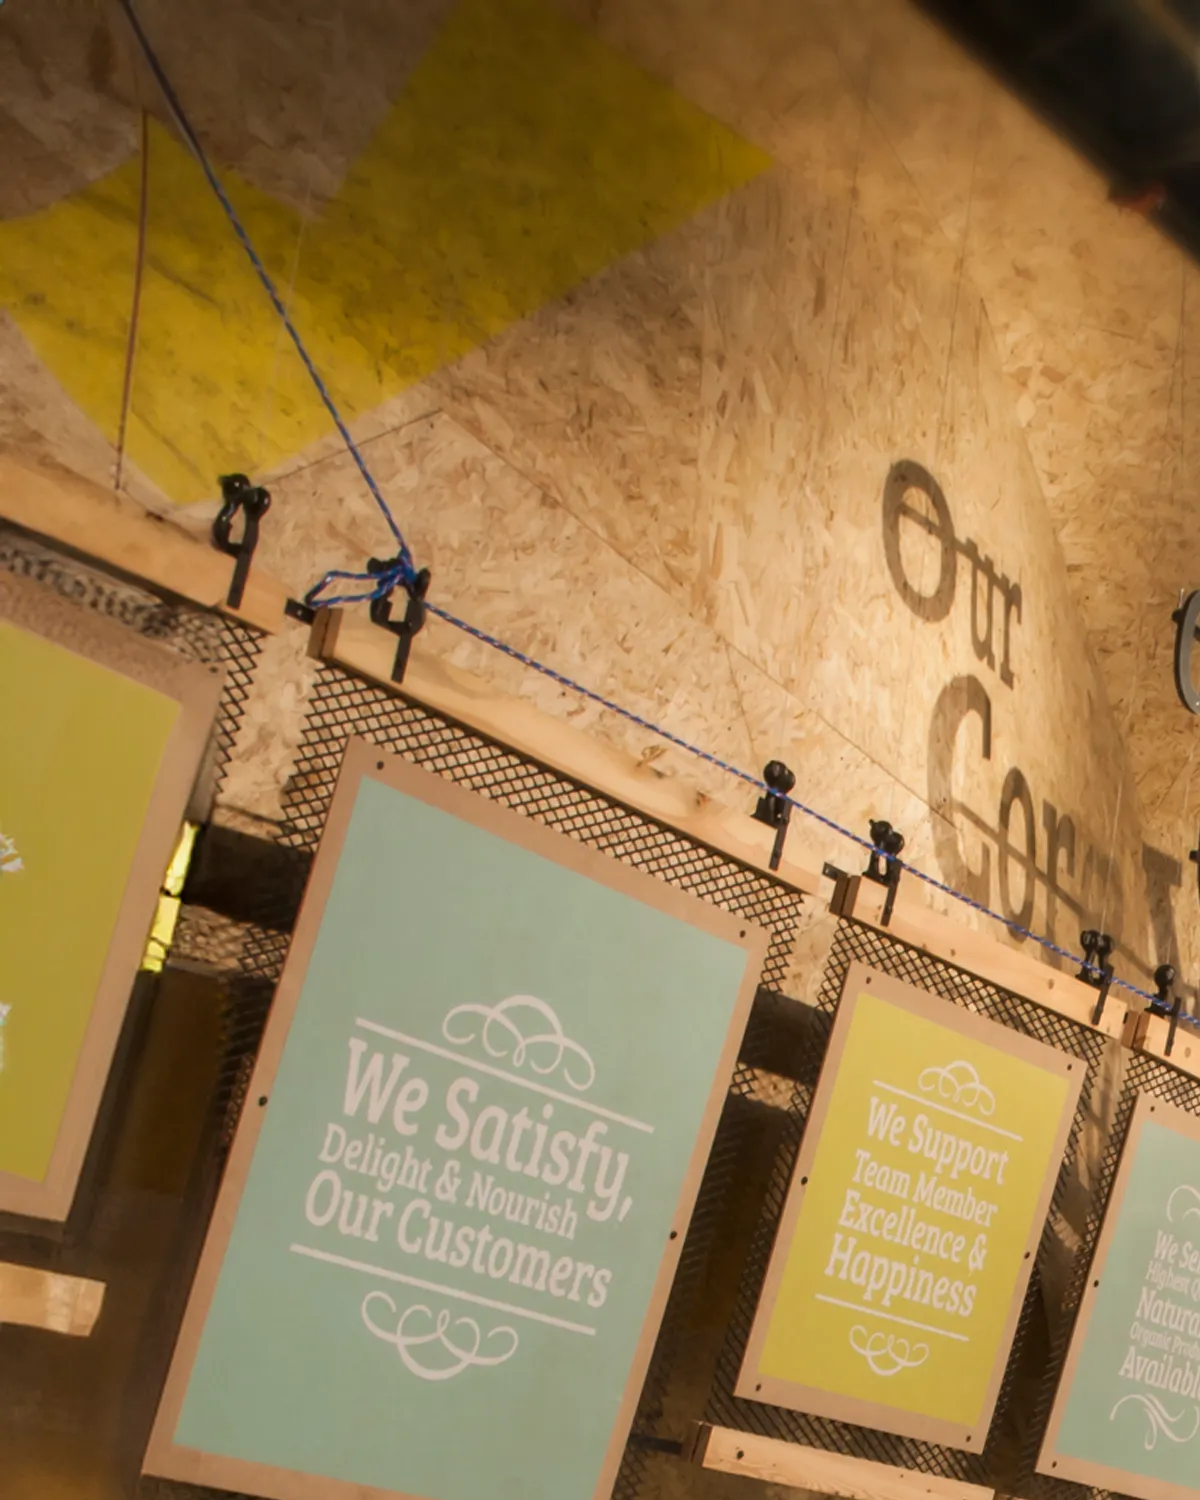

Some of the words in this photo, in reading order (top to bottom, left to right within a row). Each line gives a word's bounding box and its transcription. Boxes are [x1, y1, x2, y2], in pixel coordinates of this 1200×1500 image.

[343, 1038, 429, 1135] We
[435, 1077, 633, 1223] Satisfy,
[867, 1096, 906, 1147] We
[908, 1113, 1009, 1185] Support
[318, 1123, 433, 1194] Delight
[435, 1159, 460, 1201] &
[466, 1171, 578, 1240] Nourish
[853, 1149, 911, 1199] Team
[913, 1172, 998, 1227] Member
[305, 1170, 395, 1242] Our
[397, 1199, 613, 1308] Customers
[824, 1232, 977, 1317] Happiness
[838, 1189, 965, 1263] Excellence
[968, 1233, 987, 1273] &
[1155, 1230, 1178, 1264] We
